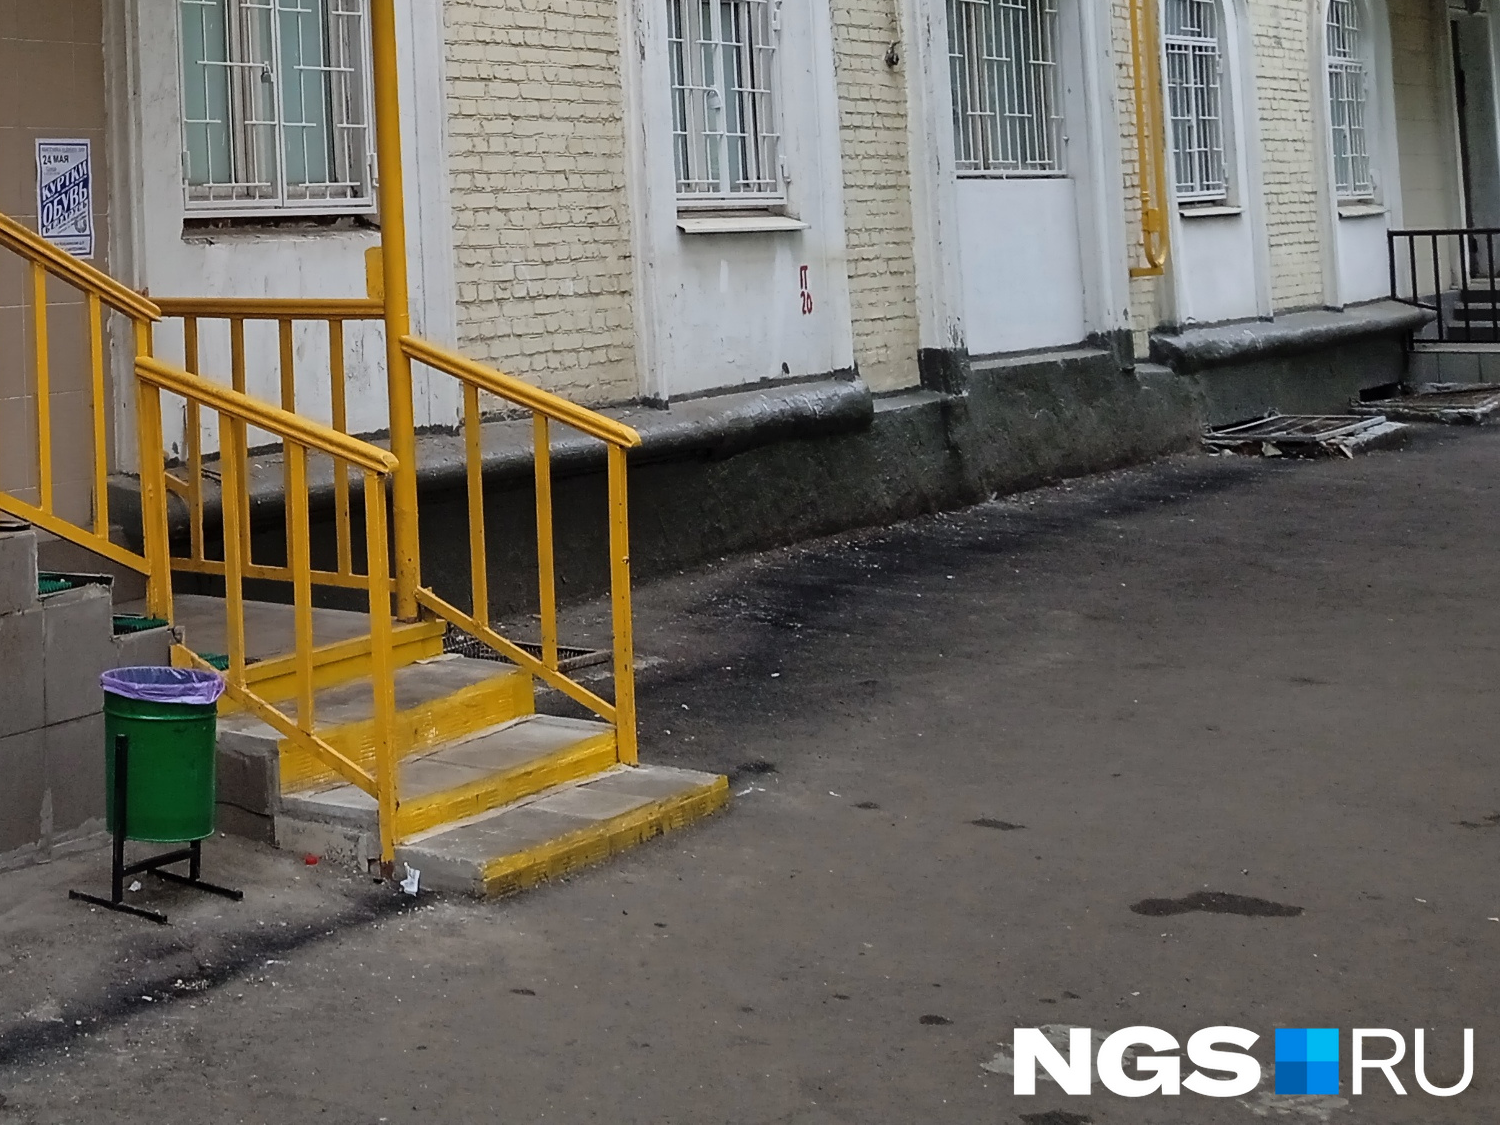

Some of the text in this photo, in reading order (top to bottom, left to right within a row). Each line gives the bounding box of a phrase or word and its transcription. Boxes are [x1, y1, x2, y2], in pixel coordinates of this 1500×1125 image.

[42, 154, 70, 165] 24 МАЯ
[42, 160, 88, 201] КУРТКИ
[42, 181, 88, 226] ОБУВЬ
